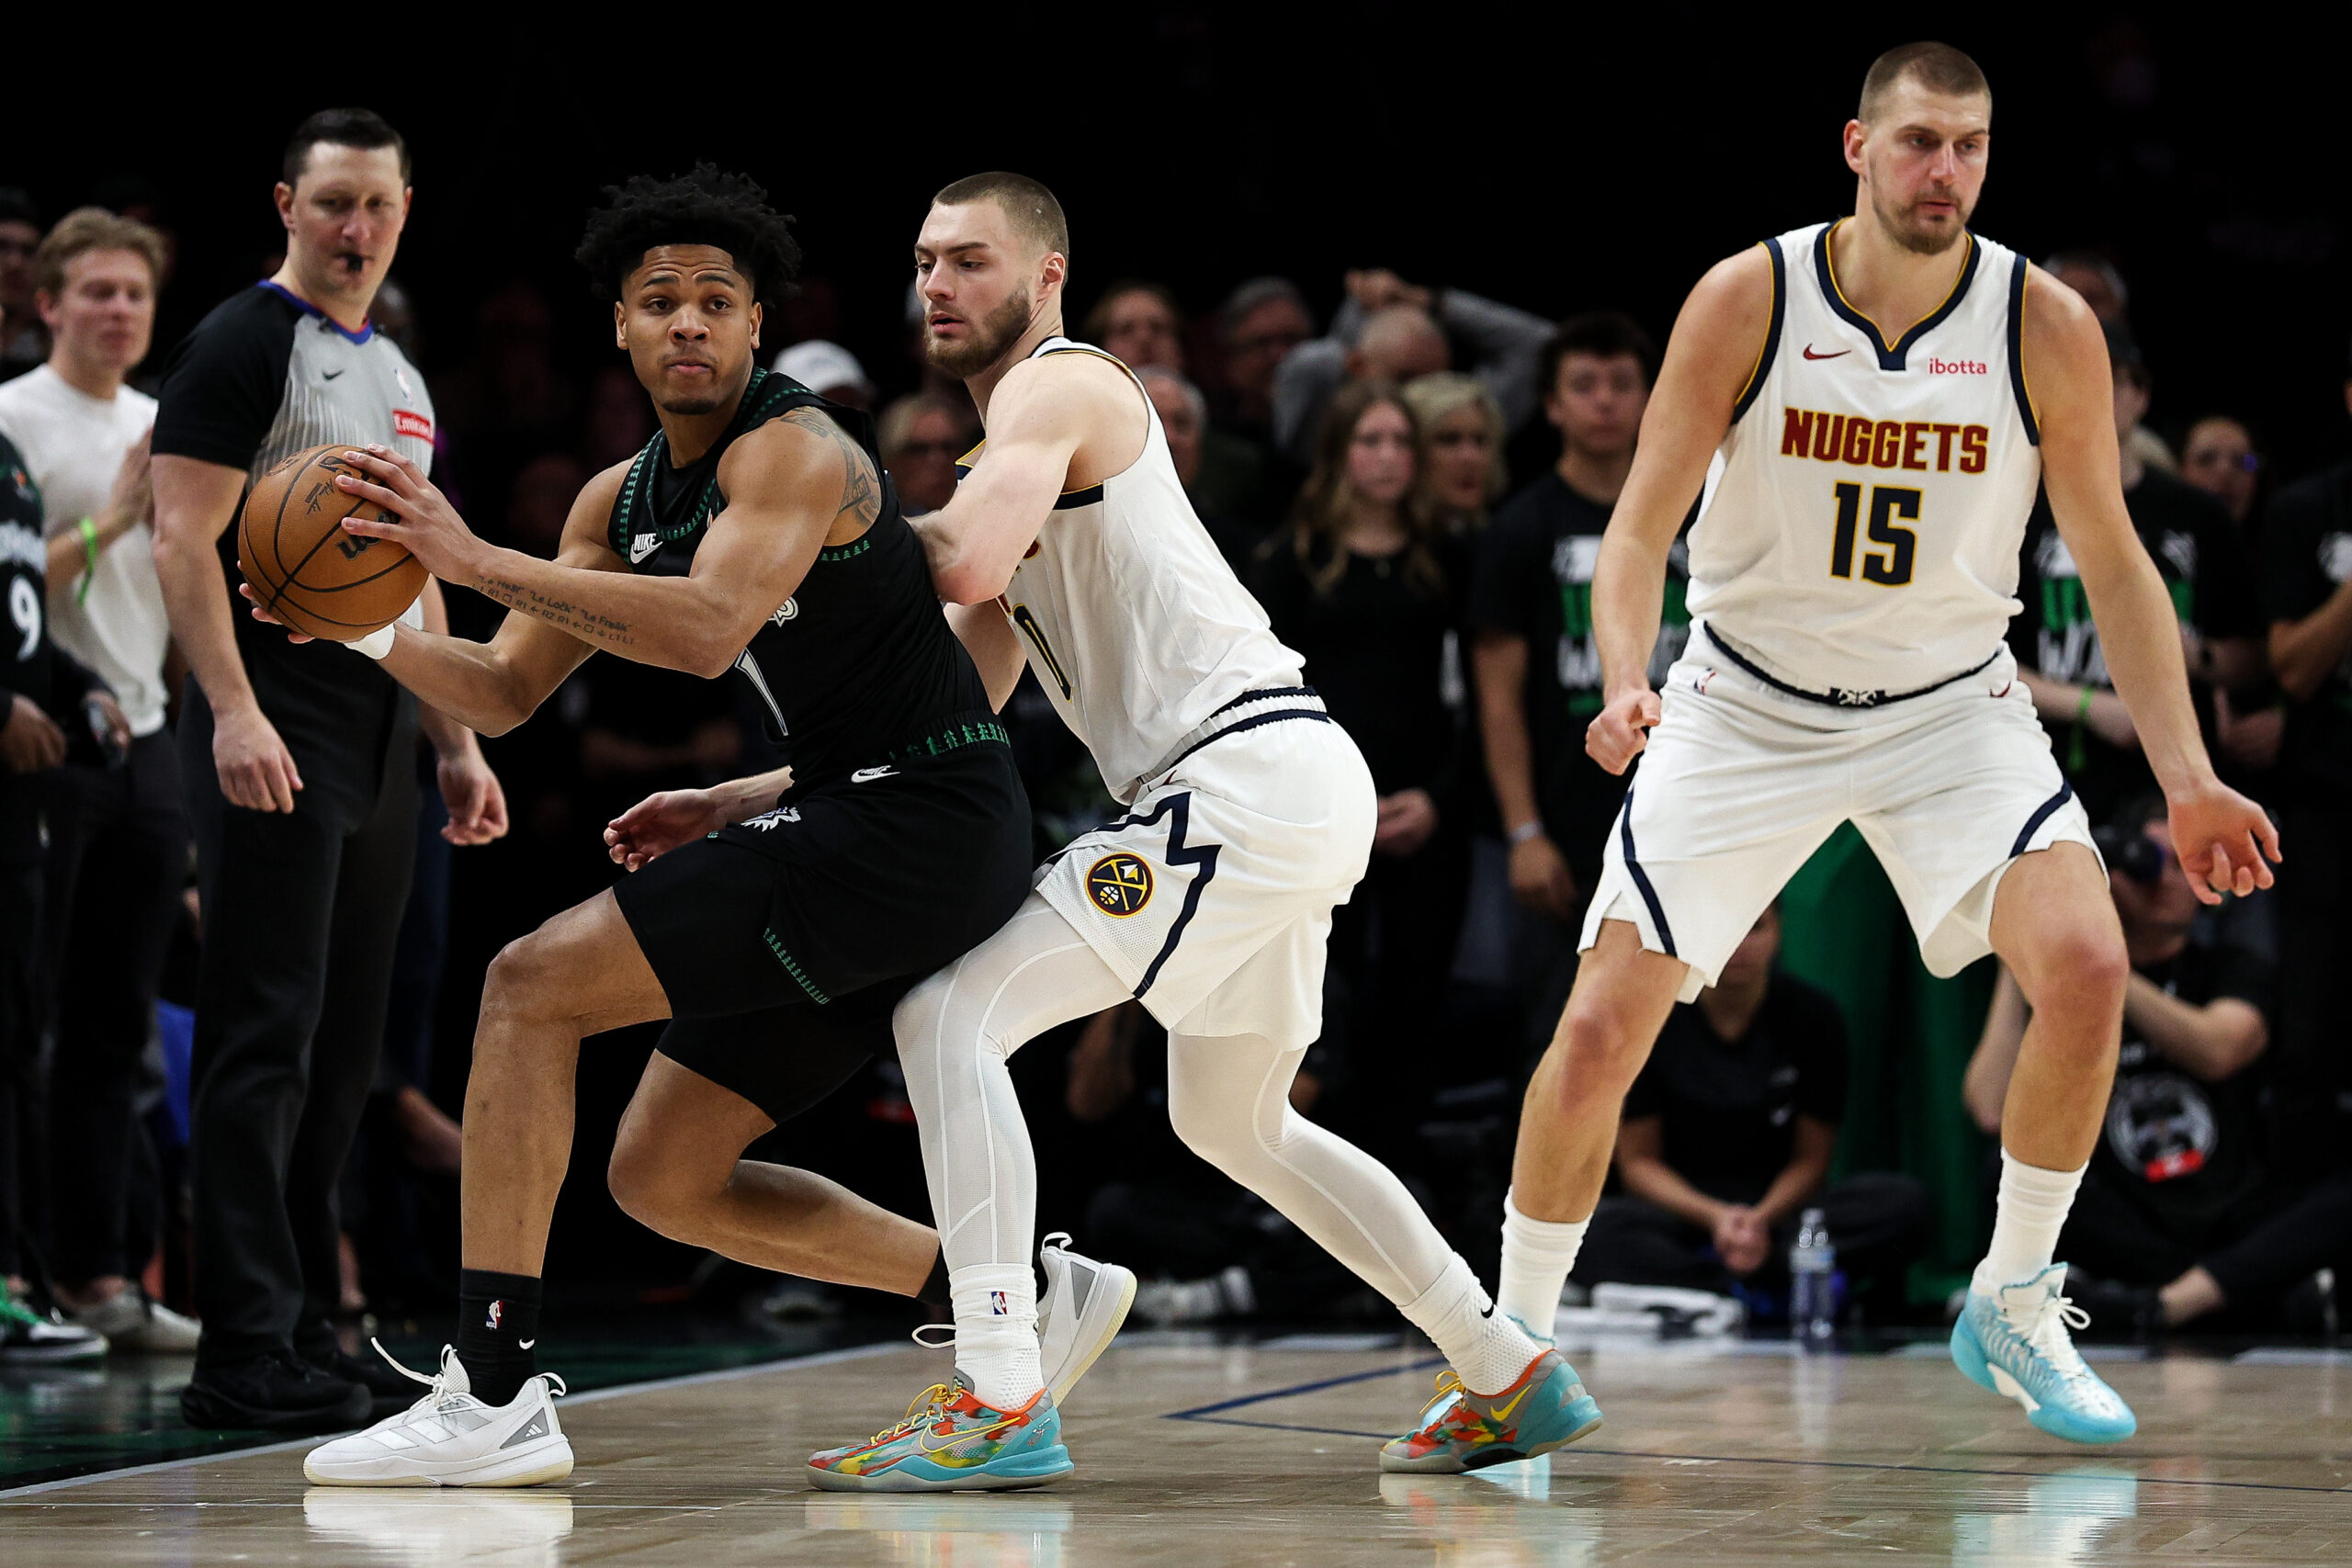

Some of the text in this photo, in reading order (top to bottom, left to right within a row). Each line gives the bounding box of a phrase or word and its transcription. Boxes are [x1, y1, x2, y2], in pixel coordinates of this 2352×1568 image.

[1928, 358, 1987, 375] ibotta
[1781, 406, 1989, 474] NUGGETS
[634, 533, 657, 551] NIKE
[1829, 479, 1924, 588] 15
[8, 573, 42, 661] 9
[542, 610, 555, 621] R2
